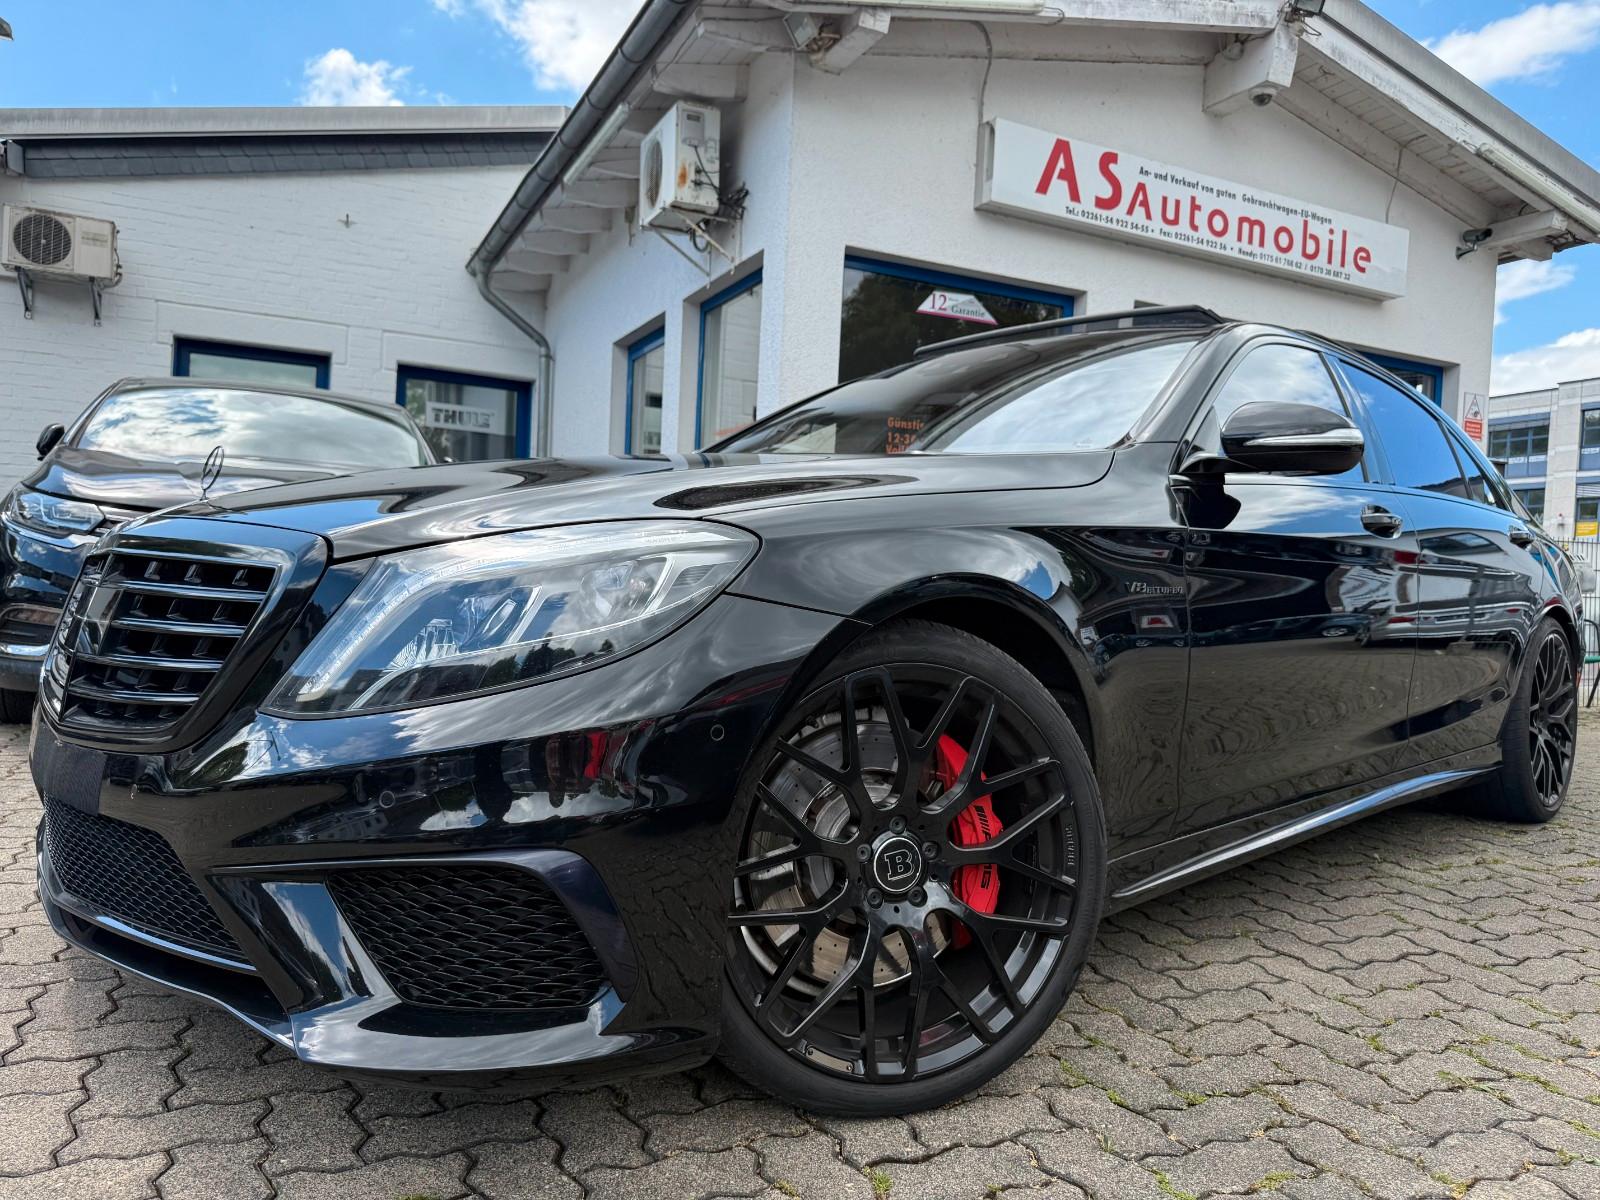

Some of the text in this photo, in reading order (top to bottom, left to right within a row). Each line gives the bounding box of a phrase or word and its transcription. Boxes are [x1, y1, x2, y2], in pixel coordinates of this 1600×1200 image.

[1139, 166, 1152, 176] An-
[1154, 172, 1168, 182] und
[1170, 174, 1199, 190] Verkauf
[1201, 184, 1214, 194] von
[1216, 189, 1237, 200] guten
[1065, 206, 1079, 217] Tel.:
[1159, 228, 1173, 239] Fax:
[930, 293, 947, 311] 12
[951, 305, 986, 318] Garantie
[884, 849, 915, 881] B
